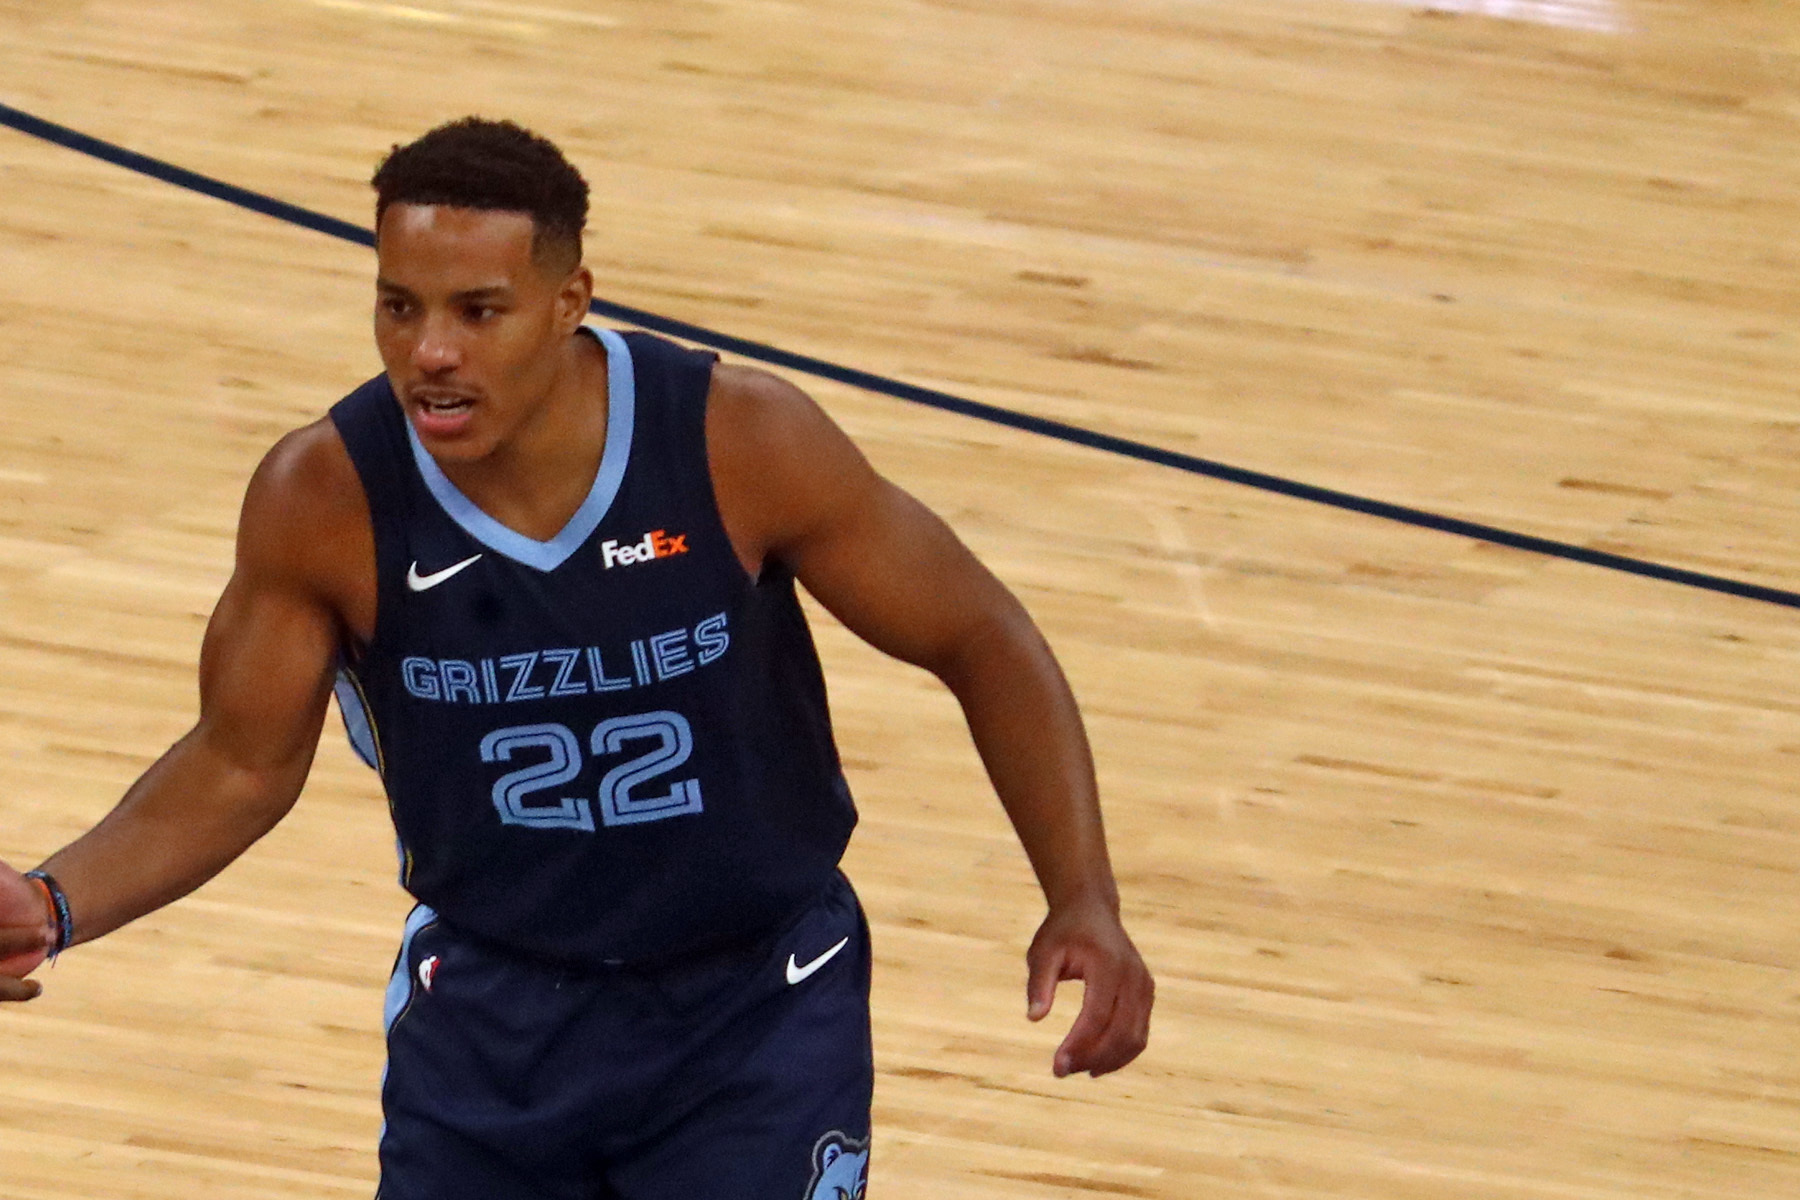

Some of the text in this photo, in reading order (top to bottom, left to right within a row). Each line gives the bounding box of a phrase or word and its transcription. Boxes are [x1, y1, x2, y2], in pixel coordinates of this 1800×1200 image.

[601, 529, 690, 569] FedEx
[402, 610, 730, 705] GRIZZLIES
[480, 709, 704, 833] 22
